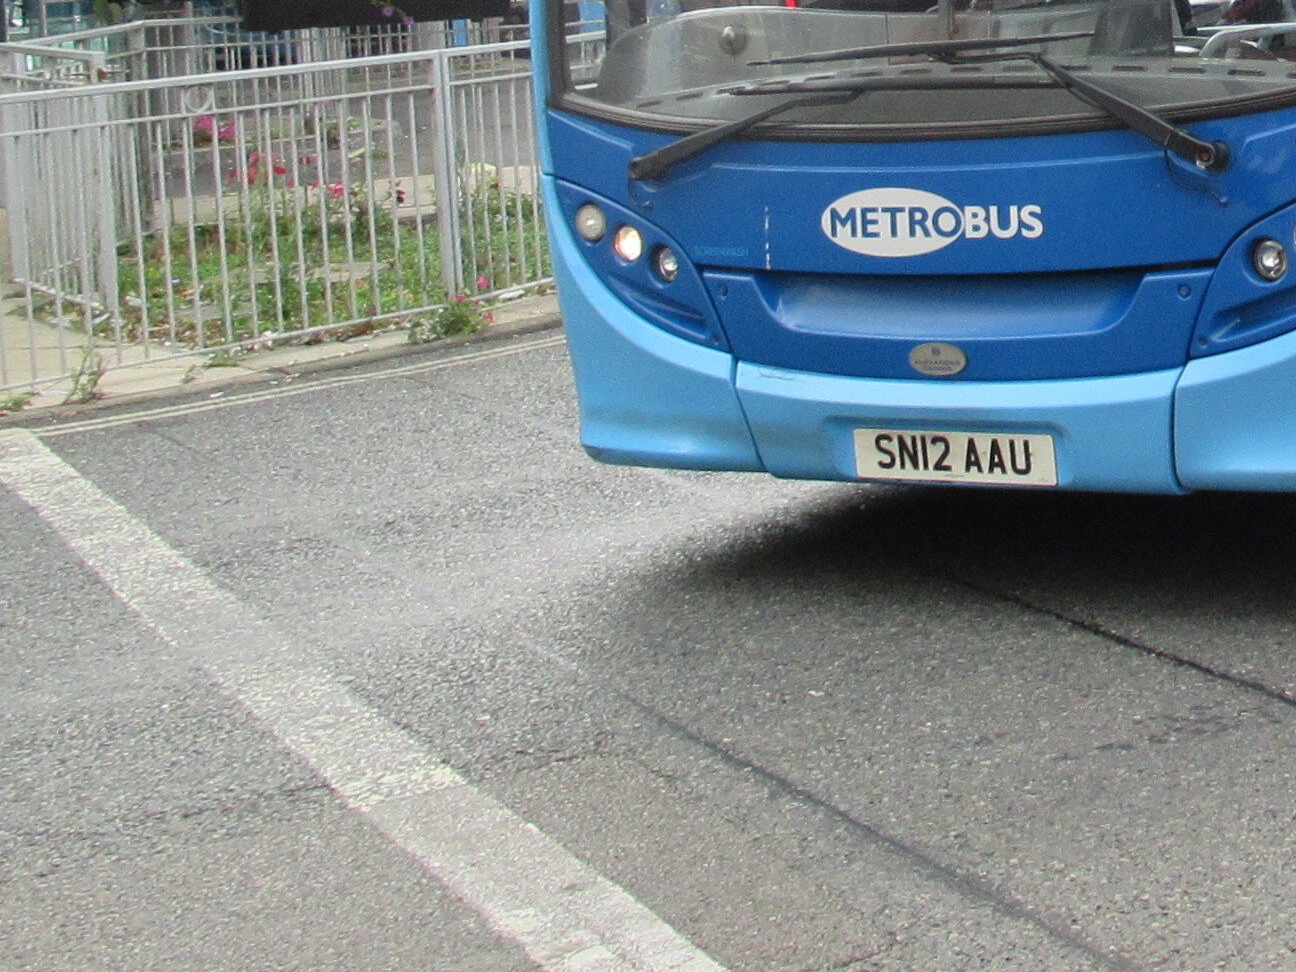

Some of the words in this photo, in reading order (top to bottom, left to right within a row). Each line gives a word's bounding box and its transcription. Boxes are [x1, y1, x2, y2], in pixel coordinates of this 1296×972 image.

[829, 204, 1044, 239] METROBUS
[874, 433, 953, 472] SN12
[964, 437, 1032, 476] AAU
